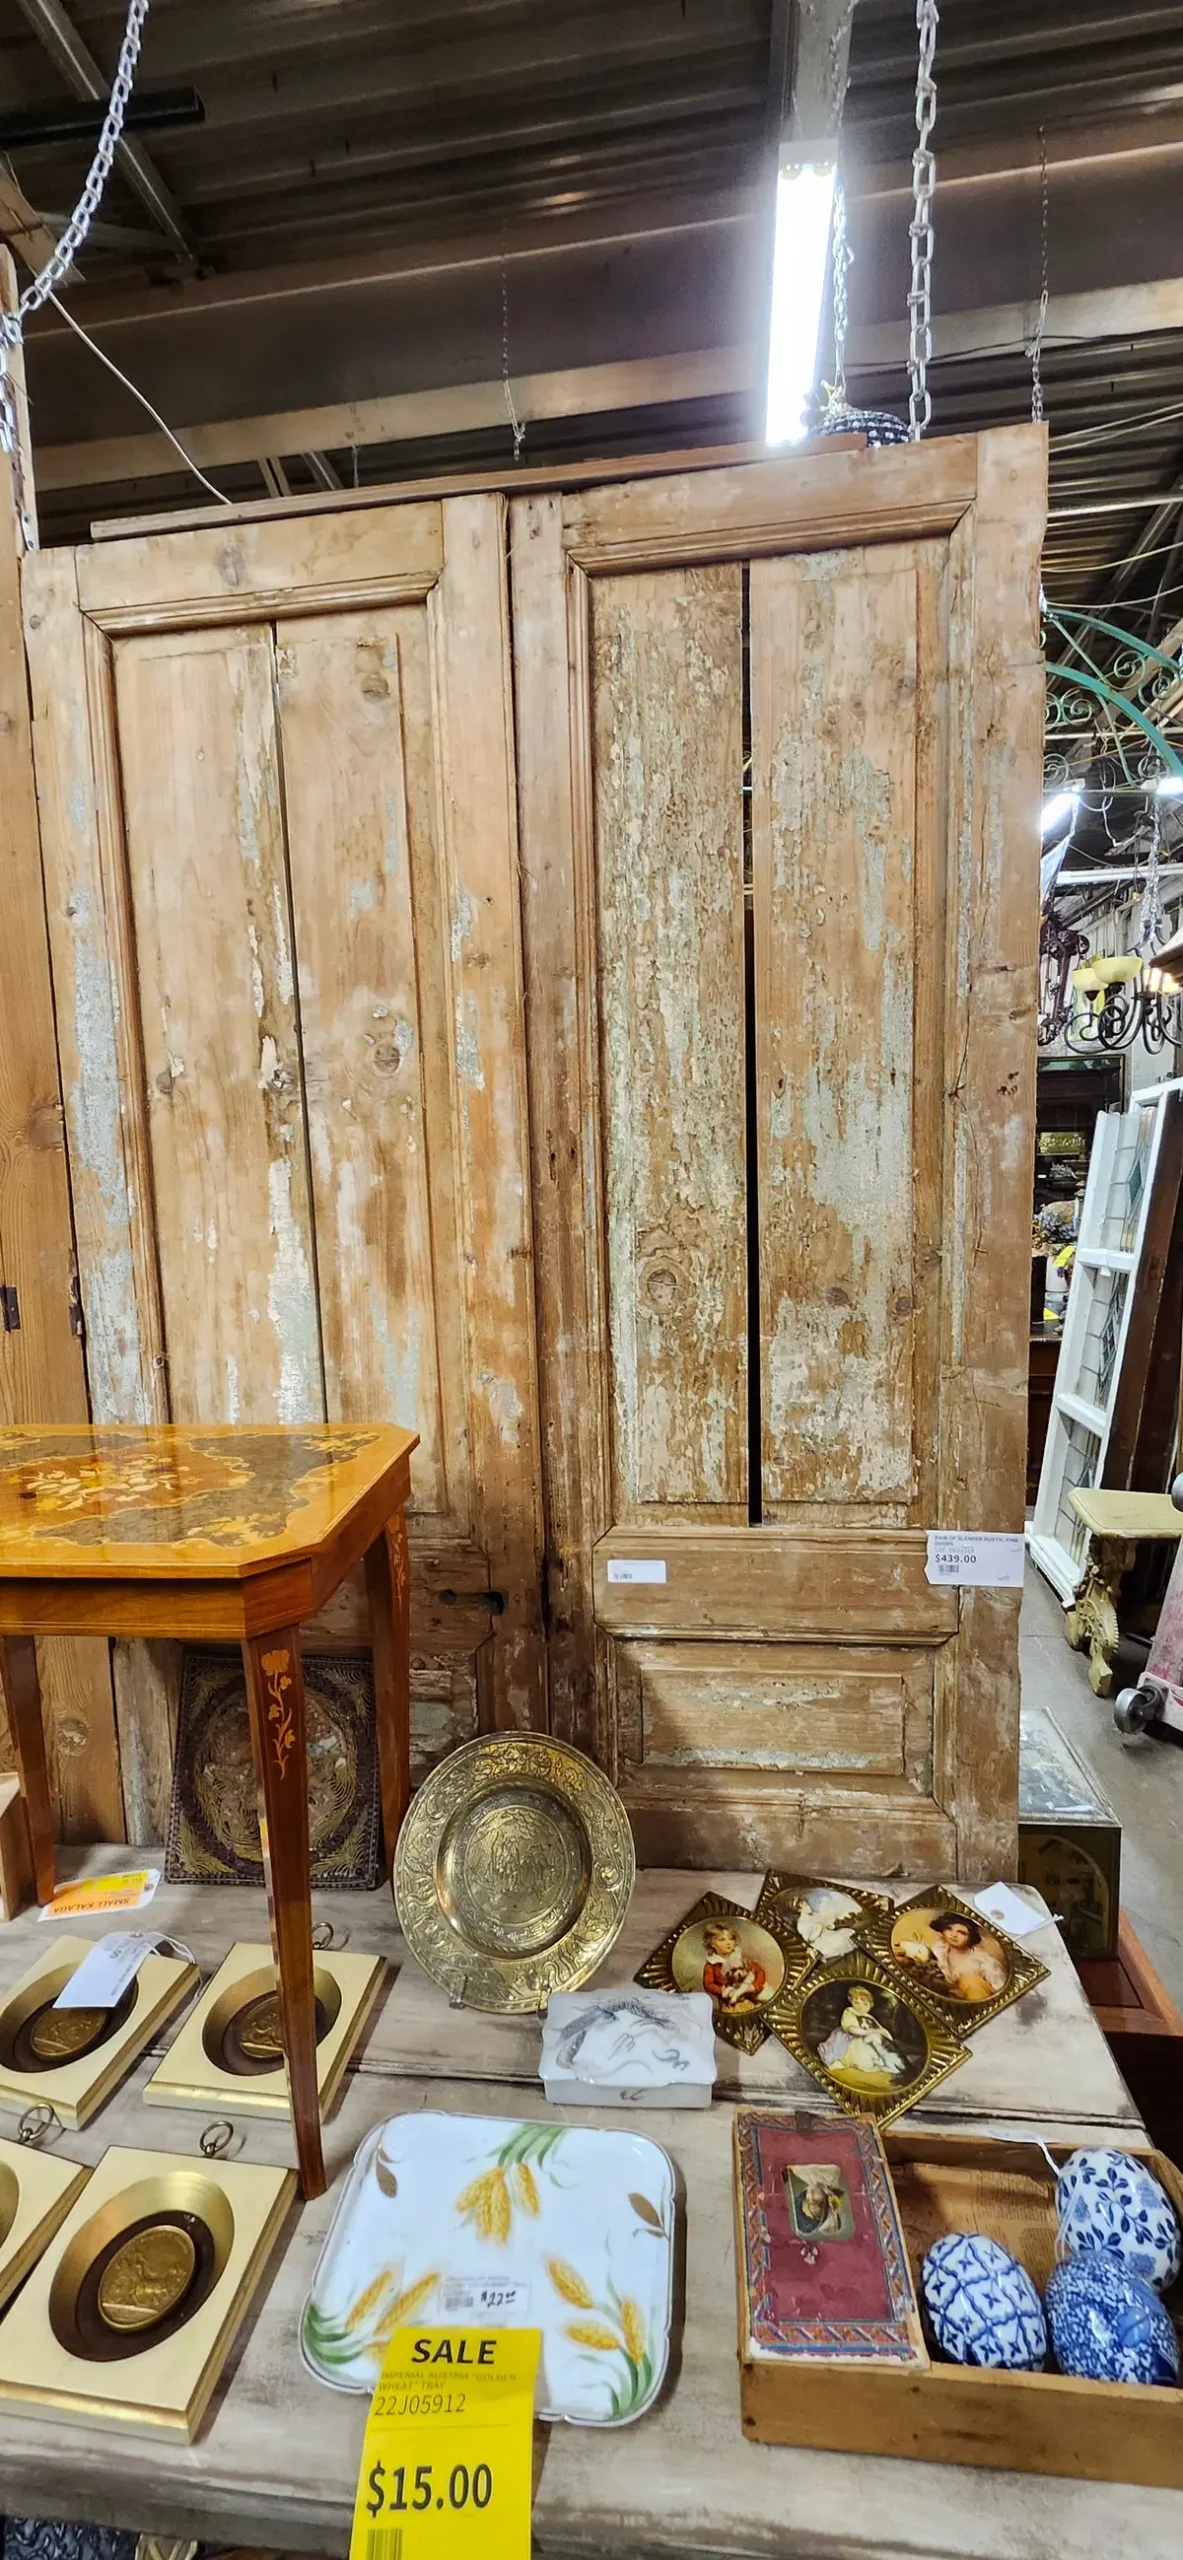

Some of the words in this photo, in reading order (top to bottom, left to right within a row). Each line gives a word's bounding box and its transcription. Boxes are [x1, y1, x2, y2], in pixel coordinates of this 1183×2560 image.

[935, 1554, 977, 1564] $439.00
[98, 1897, 130, 1907] SMALL
[411, 2338, 497, 2365] SALE
[381, 2371, 424, 2379] IMPERIAL
[427, 2371, 469, 2379] AUSTRIA
[421, 2381, 445, 2390] TRAY
[374, 2393, 467, 2416] 22J05912
[366, 2459, 492, 2518] $15.00
